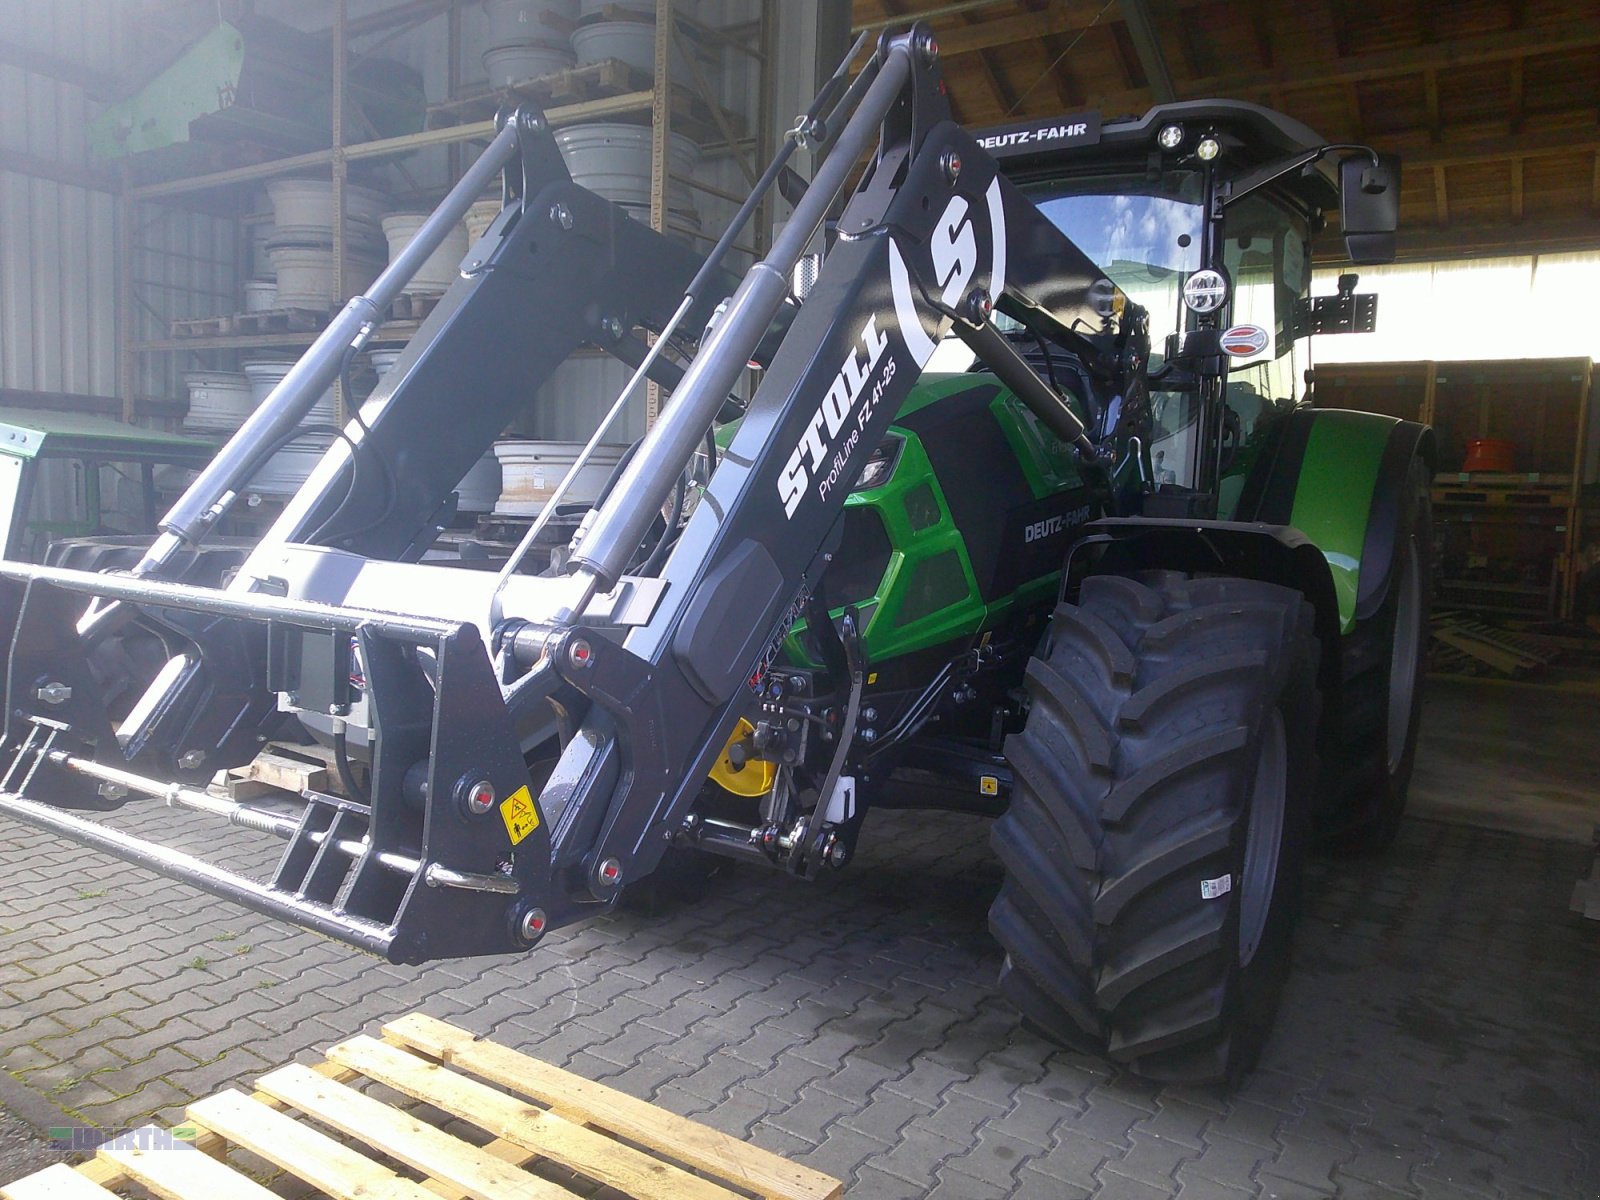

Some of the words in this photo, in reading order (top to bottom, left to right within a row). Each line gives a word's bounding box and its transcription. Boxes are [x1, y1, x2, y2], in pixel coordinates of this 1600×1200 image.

[777, 313, 888, 520] STOLL
[818, 427, 860, 502] ProfiLine
[857, 407, 873, 430] FZ
[871, 356, 896, 405] 41-25
[1025, 505, 1090, 543] DEUTZ-FAHR
